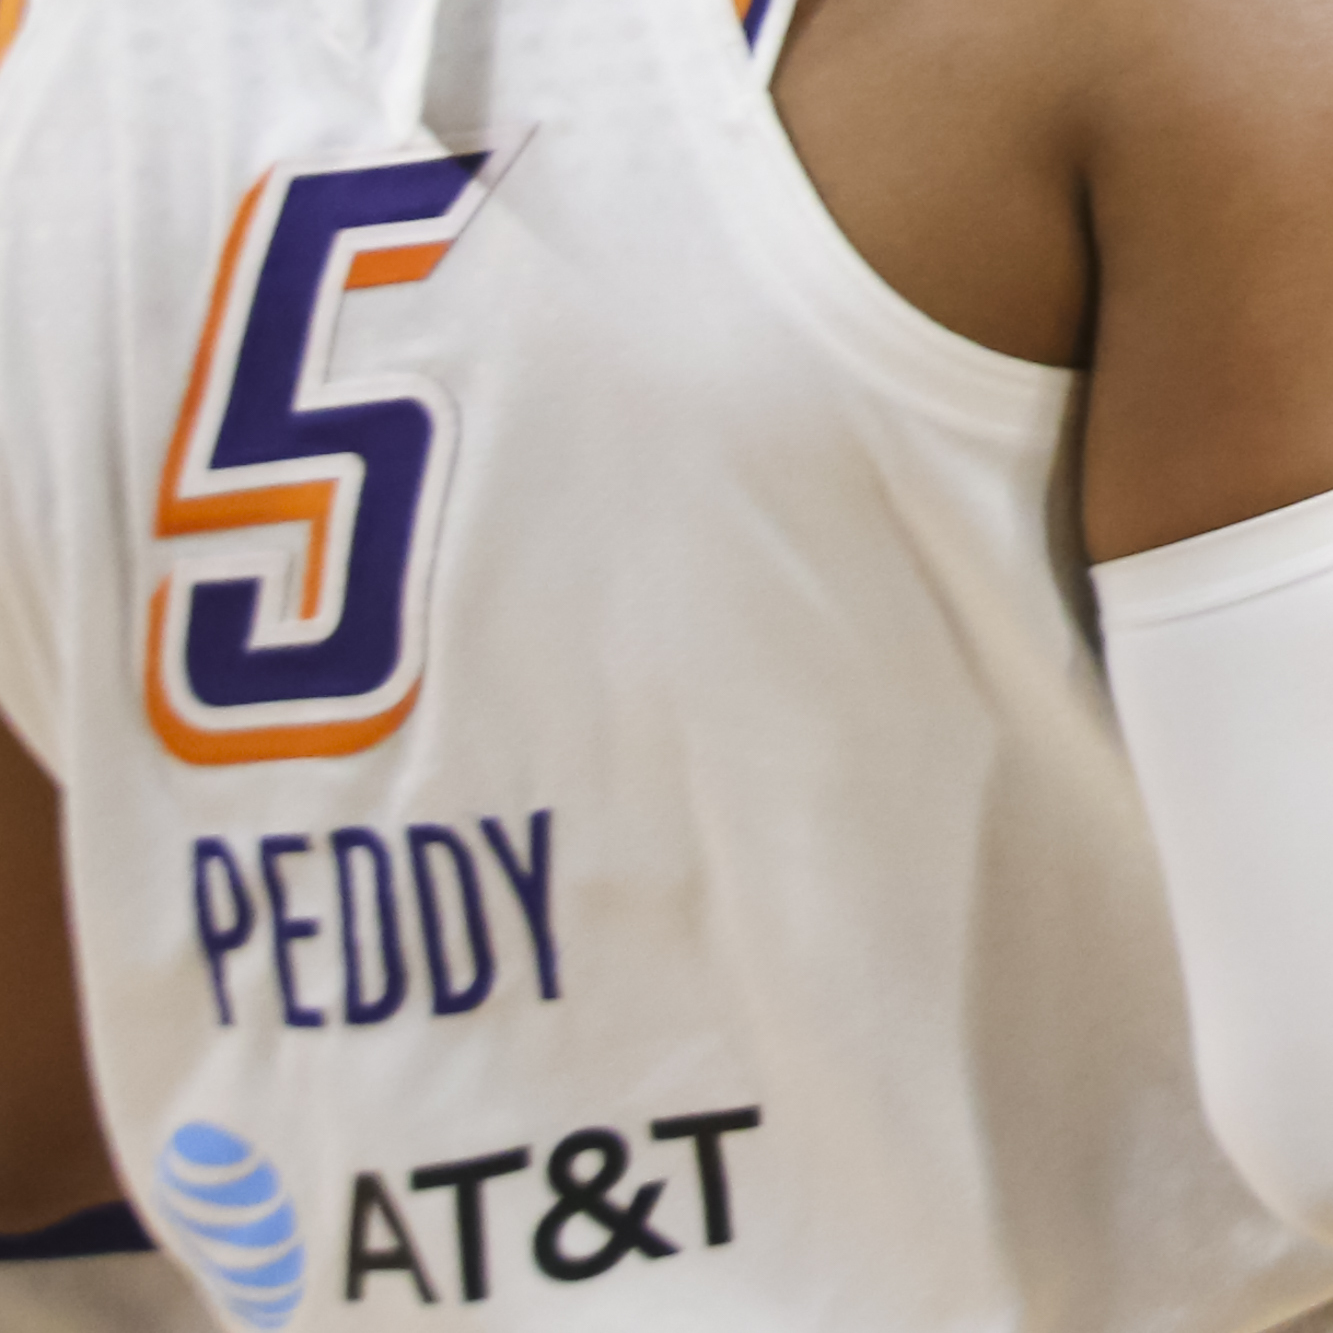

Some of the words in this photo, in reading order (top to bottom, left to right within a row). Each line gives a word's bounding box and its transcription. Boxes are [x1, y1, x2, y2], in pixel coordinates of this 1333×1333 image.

[144, 148, 492, 767] 5
[192, 808, 566, 1030] PEDDY
[343, 1105, 763, 1306] AT&T
